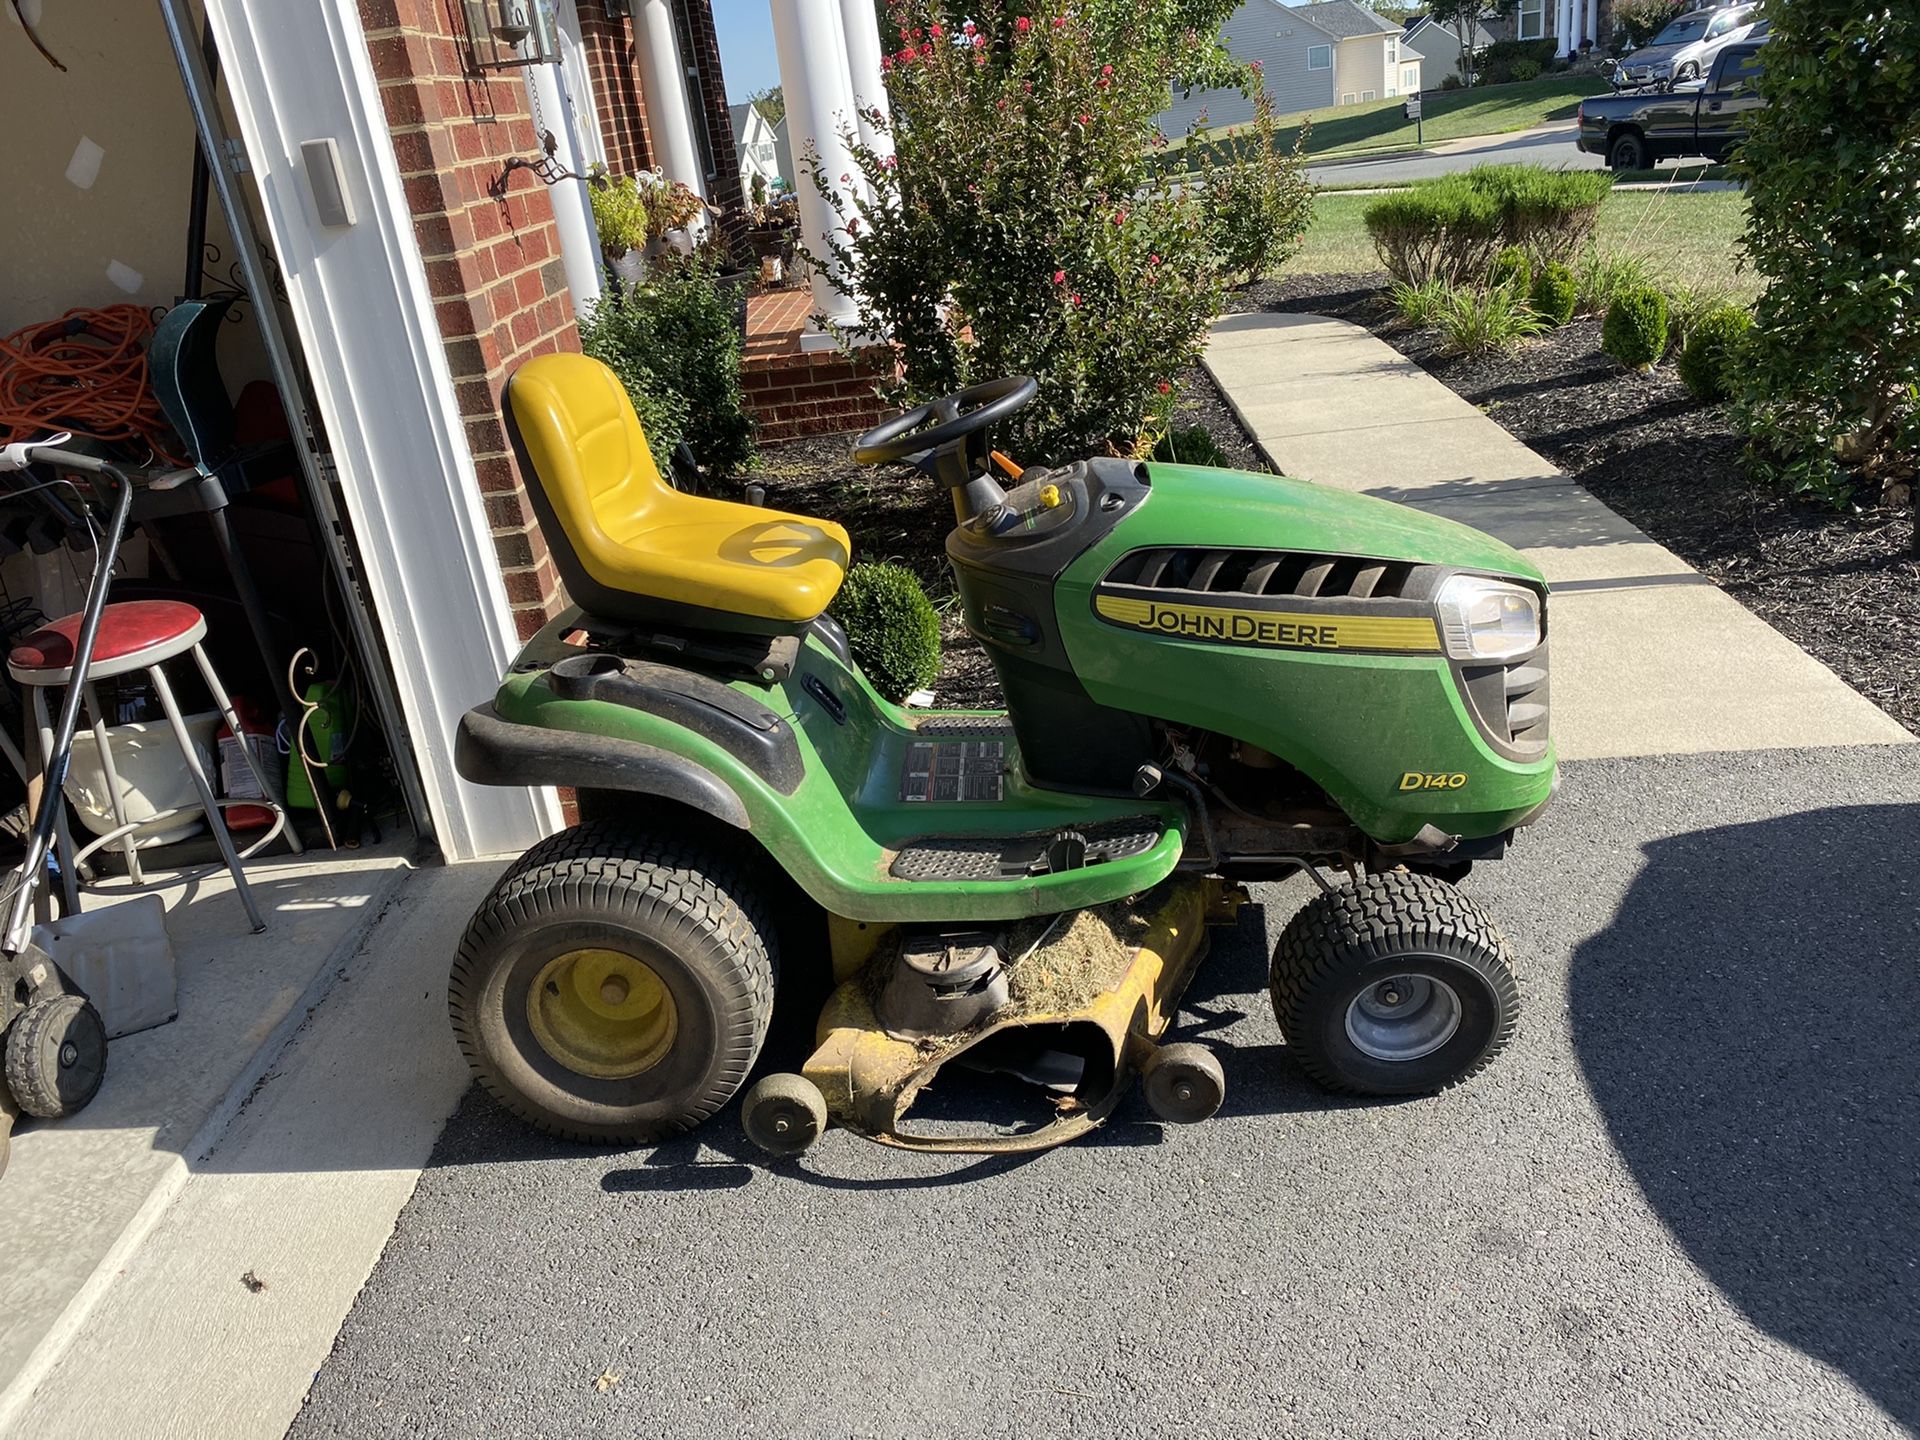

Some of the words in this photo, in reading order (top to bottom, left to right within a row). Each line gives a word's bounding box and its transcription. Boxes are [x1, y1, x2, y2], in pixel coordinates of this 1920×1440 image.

[1138, 604, 1226, 636] JOHN
[1231, 615, 1338, 645] DEERE
[1399, 772, 1467, 790] D140
